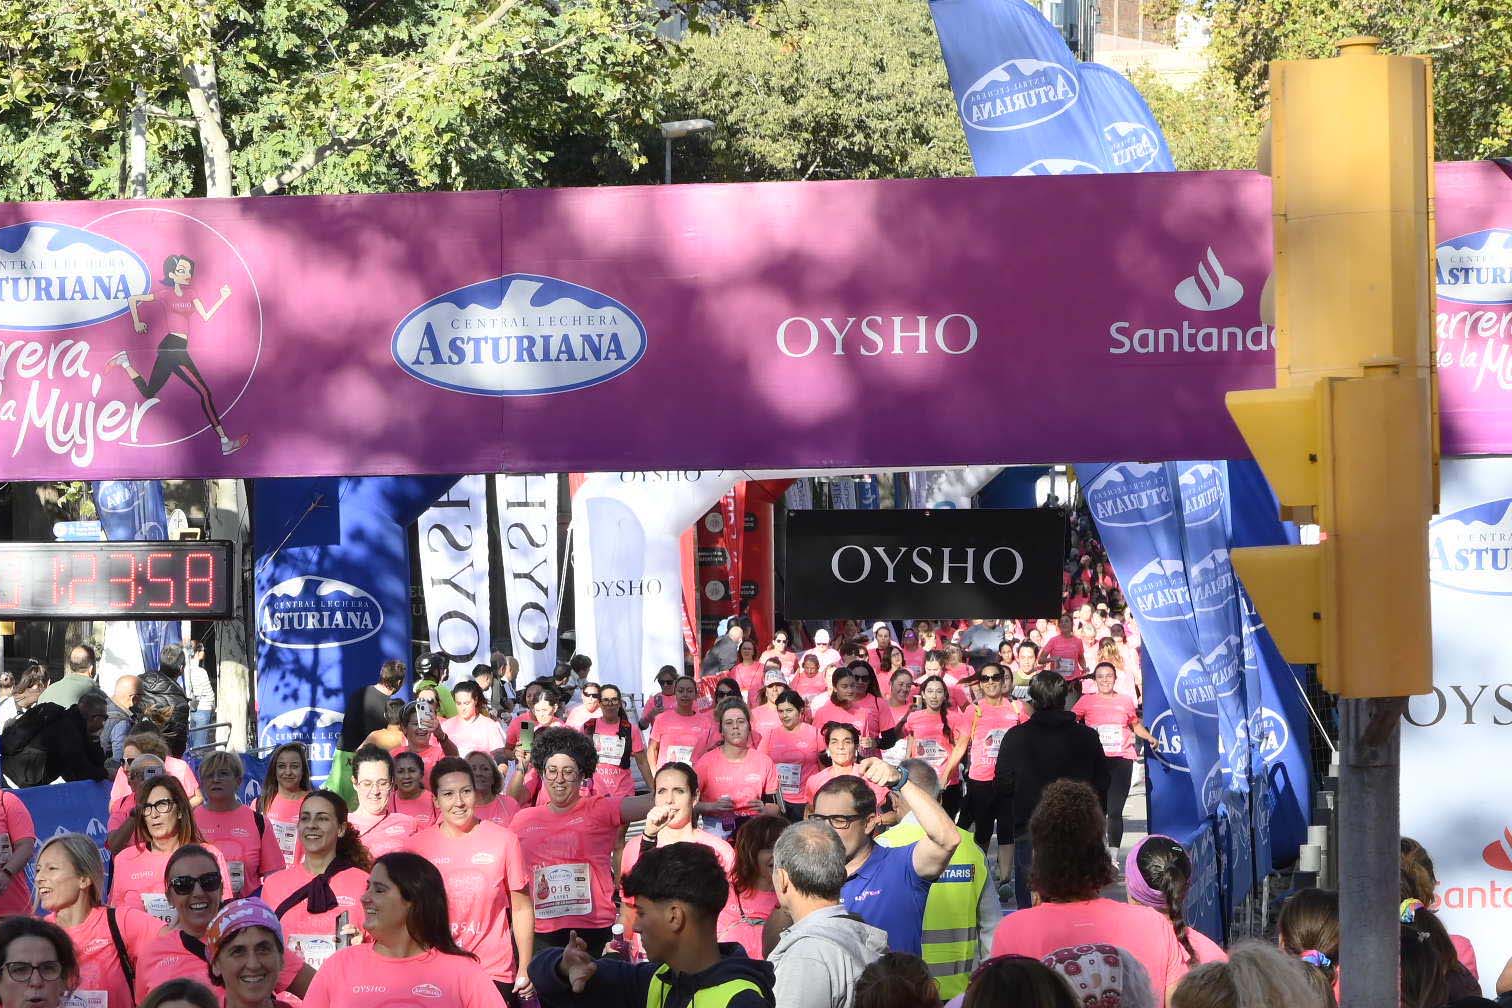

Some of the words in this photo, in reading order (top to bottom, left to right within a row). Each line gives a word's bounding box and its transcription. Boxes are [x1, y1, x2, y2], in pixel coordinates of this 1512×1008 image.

[450, 316, 529, 331] CENTRAL
[538, 314, 619, 328] LECHERA
[776, 313, 979, 358] OYSHO
[412, 321, 628, 367] ASTURIANA
[12, 373, 160, 468] Mujer
[830, 545, 1024, 586] OYSHO
[586, 578, 663, 599] OYSHO
[274, 599, 318, 610] CENTRAL
[320, 599, 370, 609] LECHERA
[262, 606, 374, 633] ASTURIANA
[450, 921, 483, 936] RSAL
